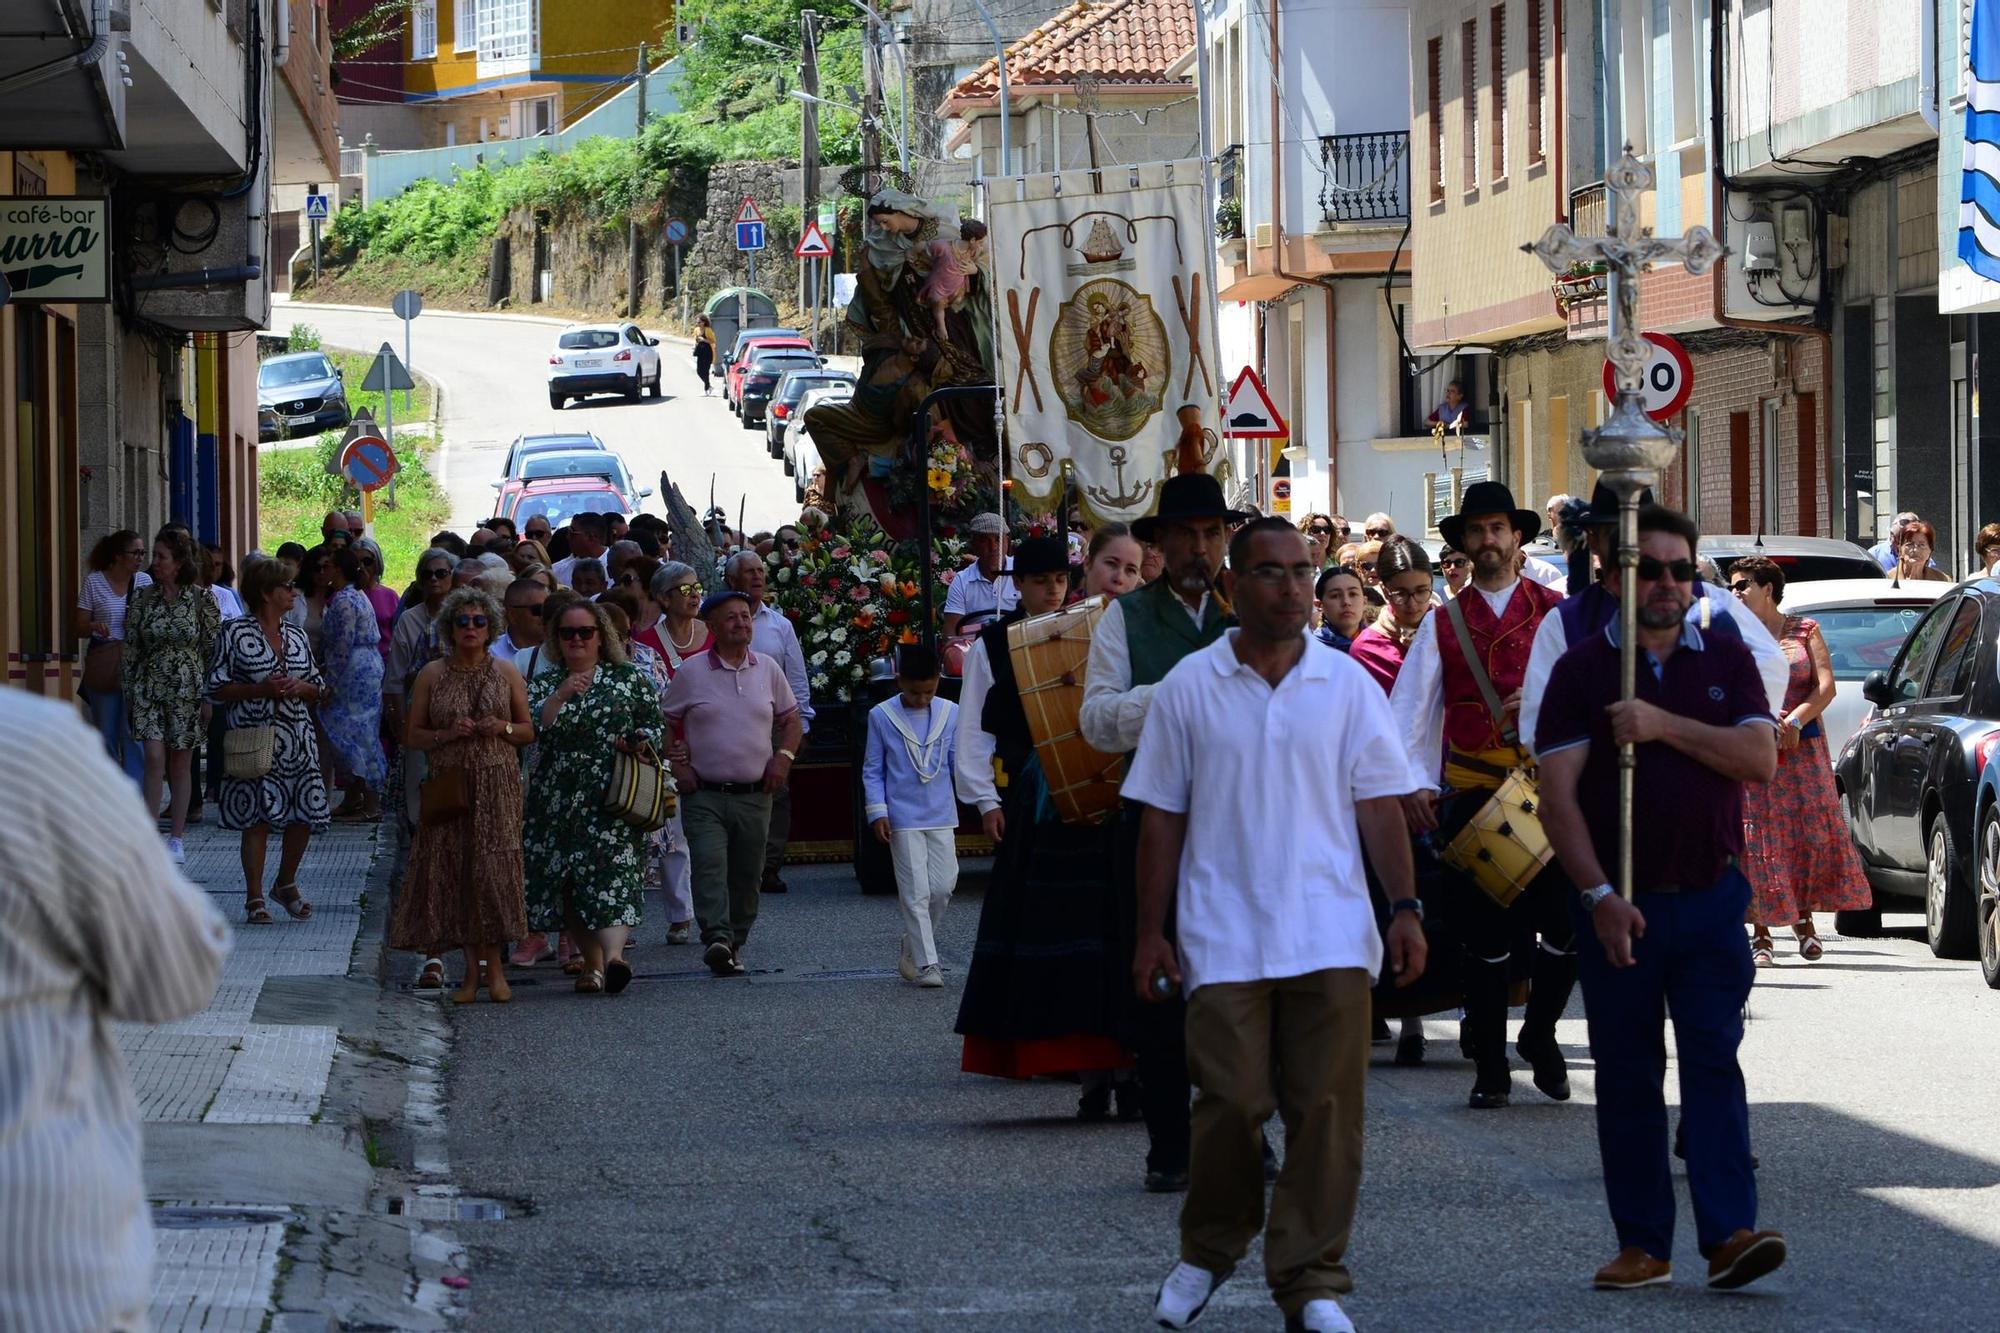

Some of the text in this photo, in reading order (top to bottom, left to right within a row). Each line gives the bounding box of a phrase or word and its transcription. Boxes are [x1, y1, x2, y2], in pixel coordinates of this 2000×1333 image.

[8, 205, 96, 224] café-bar
[0, 226, 99, 264] urra
[1639, 362, 1675, 392] 0
